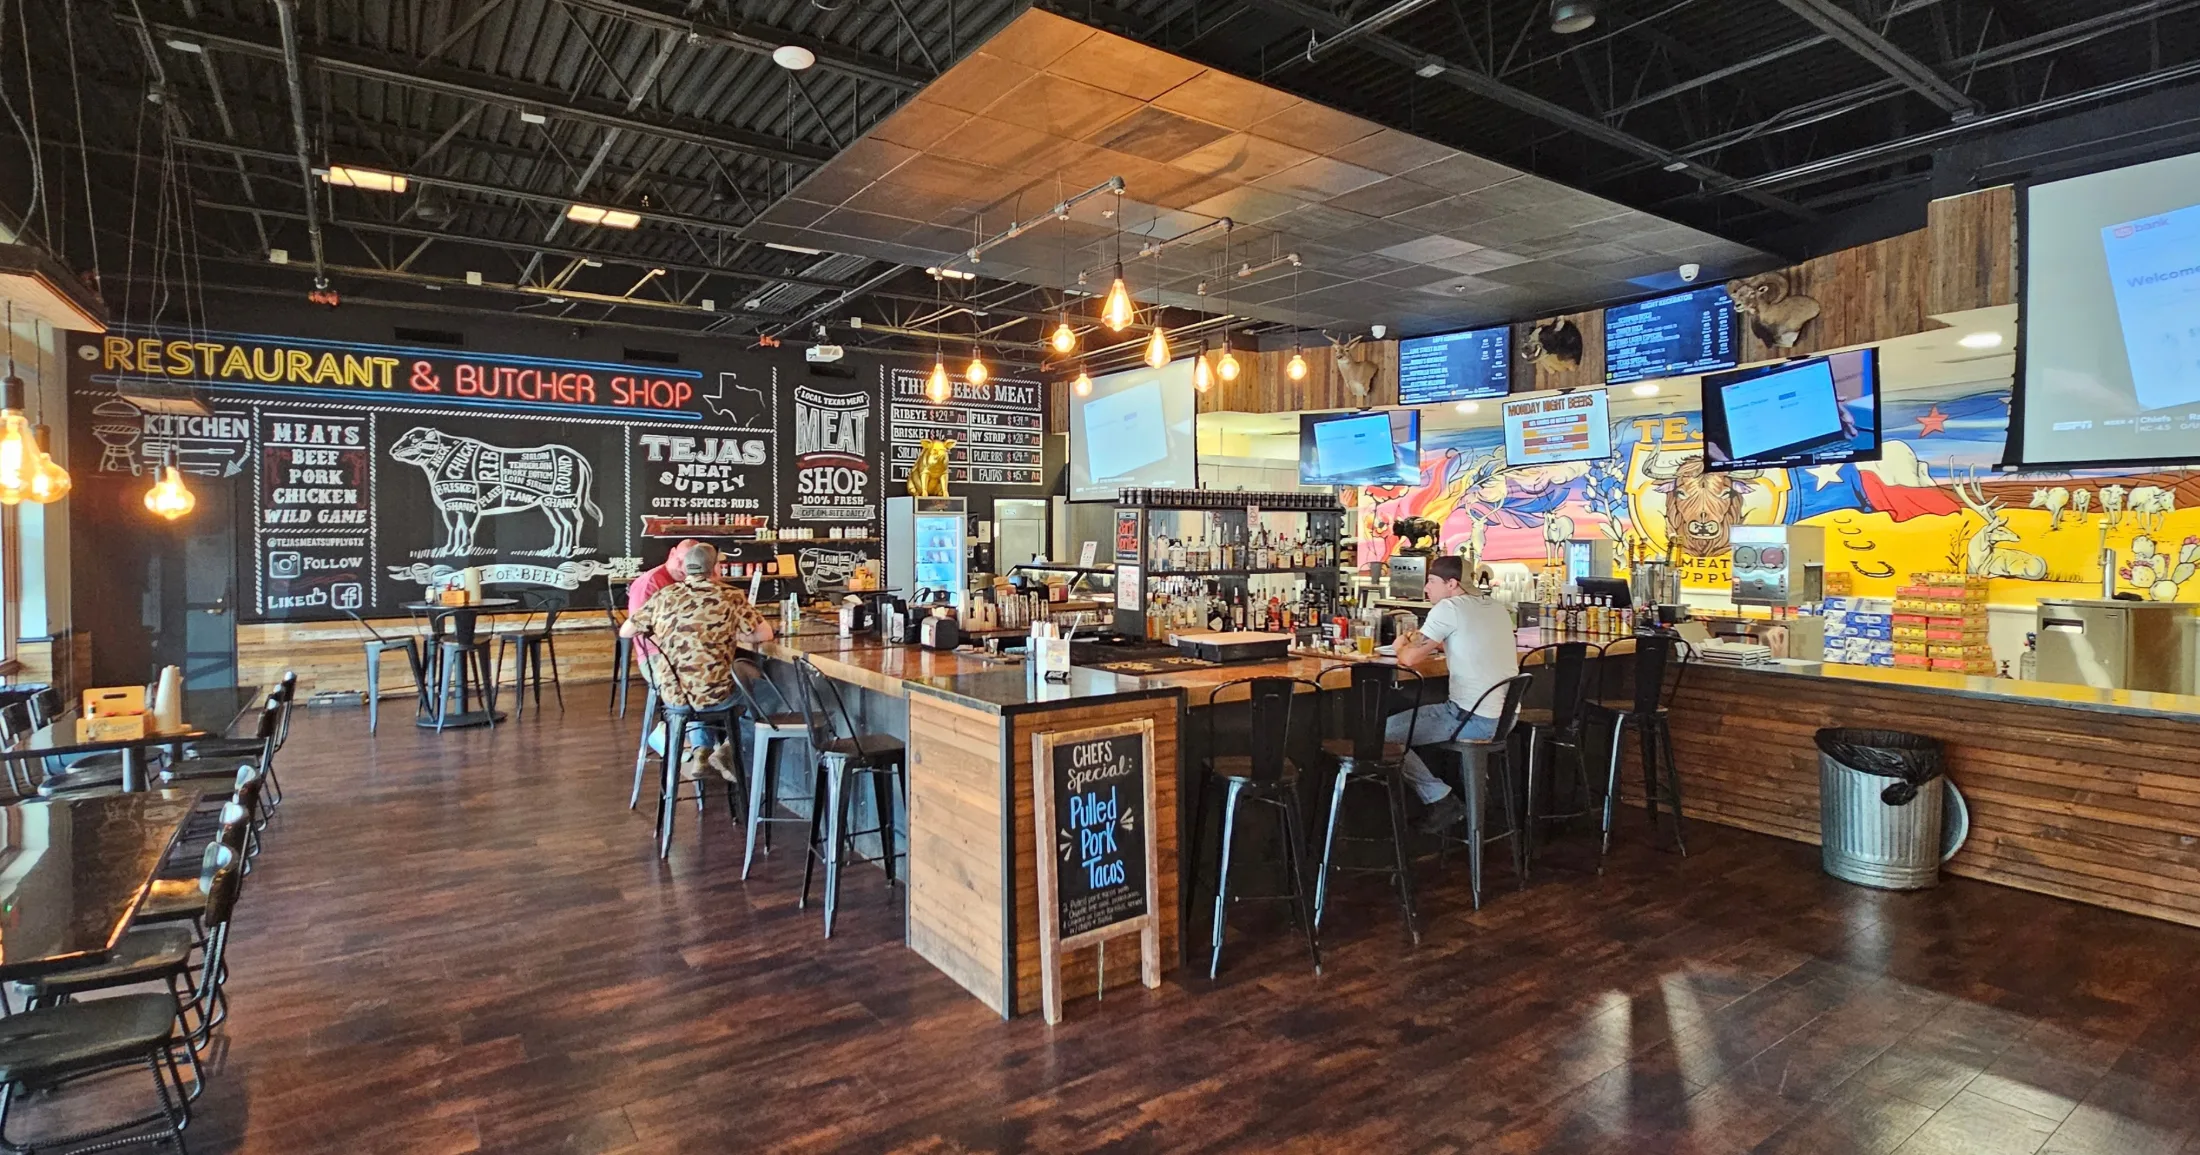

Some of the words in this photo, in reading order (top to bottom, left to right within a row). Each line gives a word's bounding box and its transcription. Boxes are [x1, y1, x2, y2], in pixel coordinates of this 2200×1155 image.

[104, 336, 399, 389] RESTAURANT
[409, 360, 441, 392] &
[456, 364, 595, 403] BUTCHER
[611, 377, 692, 408] SHOP
[801, 391, 822, 403] LOCAL
[823, 397, 845, 406] TEXAS
[846, 395, 865, 405] MEAT
[898, 376, 929, 395] THI
[947, 381, 990, 401] EEKS
[994, 384, 1034, 404] MEAT
[894, 408, 927, 420] RIBEYE
[1507, 401, 1541, 417] MONDAY
[1543, 398, 1566, 412] NIGHT
[1568, 394, 1594, 410] BEERS
[143, 414, 250, 438] KITCHEN
[972, 413, 998, 424] FILET
[2053, 420, 2092, 431] ESPN
[2140, 414, 2172, 424] Chiefs
[273, 423, 359, 445] MEATS
[796, 402, 869, 457] MEAT
[894, 427, 930, 439] BRISKET
[972, 431, 982, 442] NY
[983, 432, 1006, 443] STRIP
[291, 448, 339, 465] BEEF
[430, 443, 452, 468] NECK
[521, 452, 550, 460] SIRLOIN
[640, 434, 766, 466] TEJAS
[445, 442, 478, 479] CHUCK
[479, 450, 500, 481] RIB
[508, 461, 552, 470] TENDERLOIN
[289, 468, 343, 484] PORK
[504, 475, 525, 484] LOIN
[555, 455, 573, 493] ROUND
[678, 464, 732, 478] MEAT
[434, 482, 476, 496] BRISKET
[659, 471, 745, 494] SUPPLY
[798, 467, 868, 495] SHOP
[272, 487, 357, 504] CHICKEN
[480, 485, 502, 508] PLATE
[505, 490, 536, 503] FLANK
[544, 497, 577, 509] SHANK
[803, 495, 830, 505] 100%
[834, 496, 864, 505] FRESH
[264, 508, 312, 523] WILD
[317, 509, 367, 523] GAME
[446, 502, 477, 513] SHANK
[829, 509, 844, 517] SITE
[846, 509, 866, 517] DAILY
[820, 554, 838, 565] LOIN
[1682, 558, 1730, 568] MEAT
[449, 571, 486, 588] CT
[497, 570, 516, 580] OF
[521, 571, 566, 585] BEEF
[1073, 741, 1112, 768] CHEFS
[1070, 785, 1117, 829] Pulled
[1081, 856, 1126, 890] Tacos
